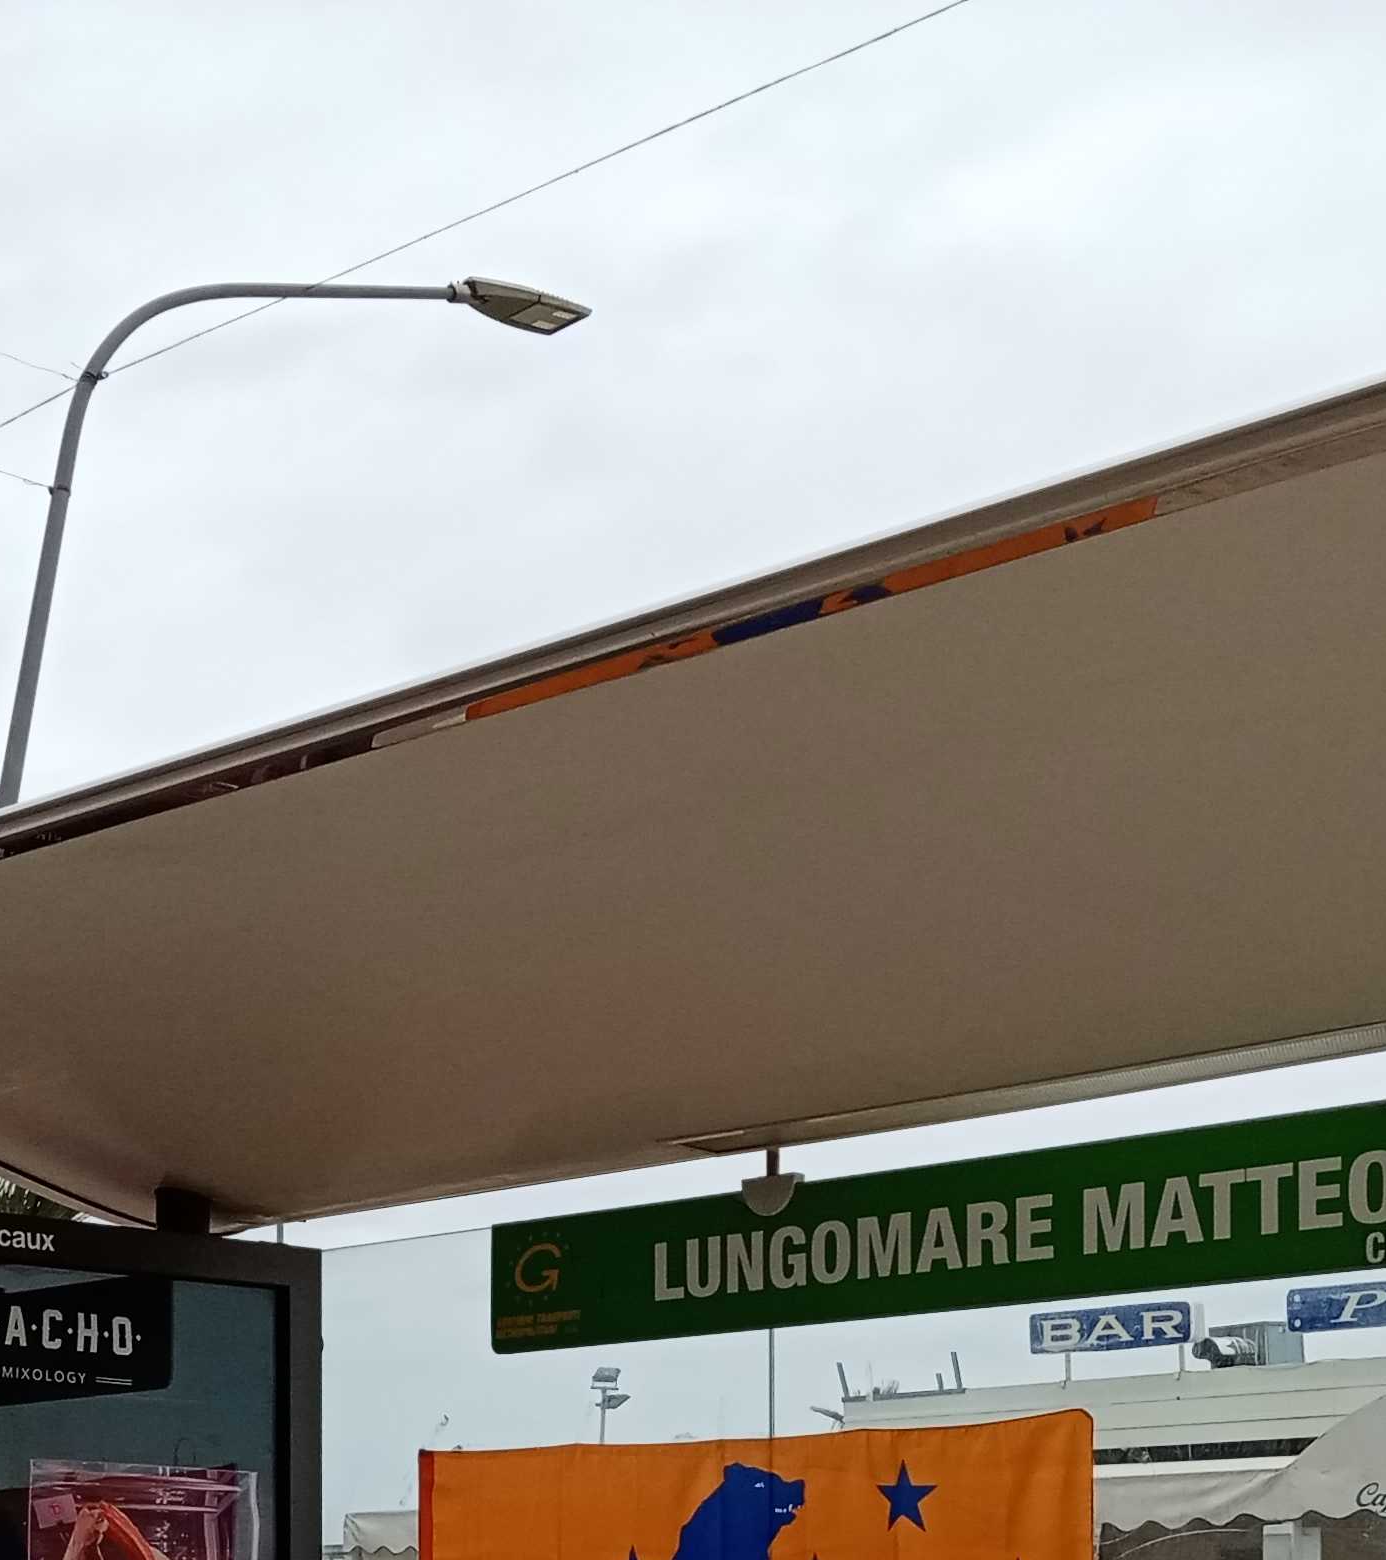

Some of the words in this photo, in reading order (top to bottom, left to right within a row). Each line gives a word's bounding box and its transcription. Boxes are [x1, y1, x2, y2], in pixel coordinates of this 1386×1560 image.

[653, 1192, 1055, 1303] LUNGOMARE
[1040, 1307, 1183, 1350] BAR
[2, 1366, 87, 1385] MIXOLOGY
